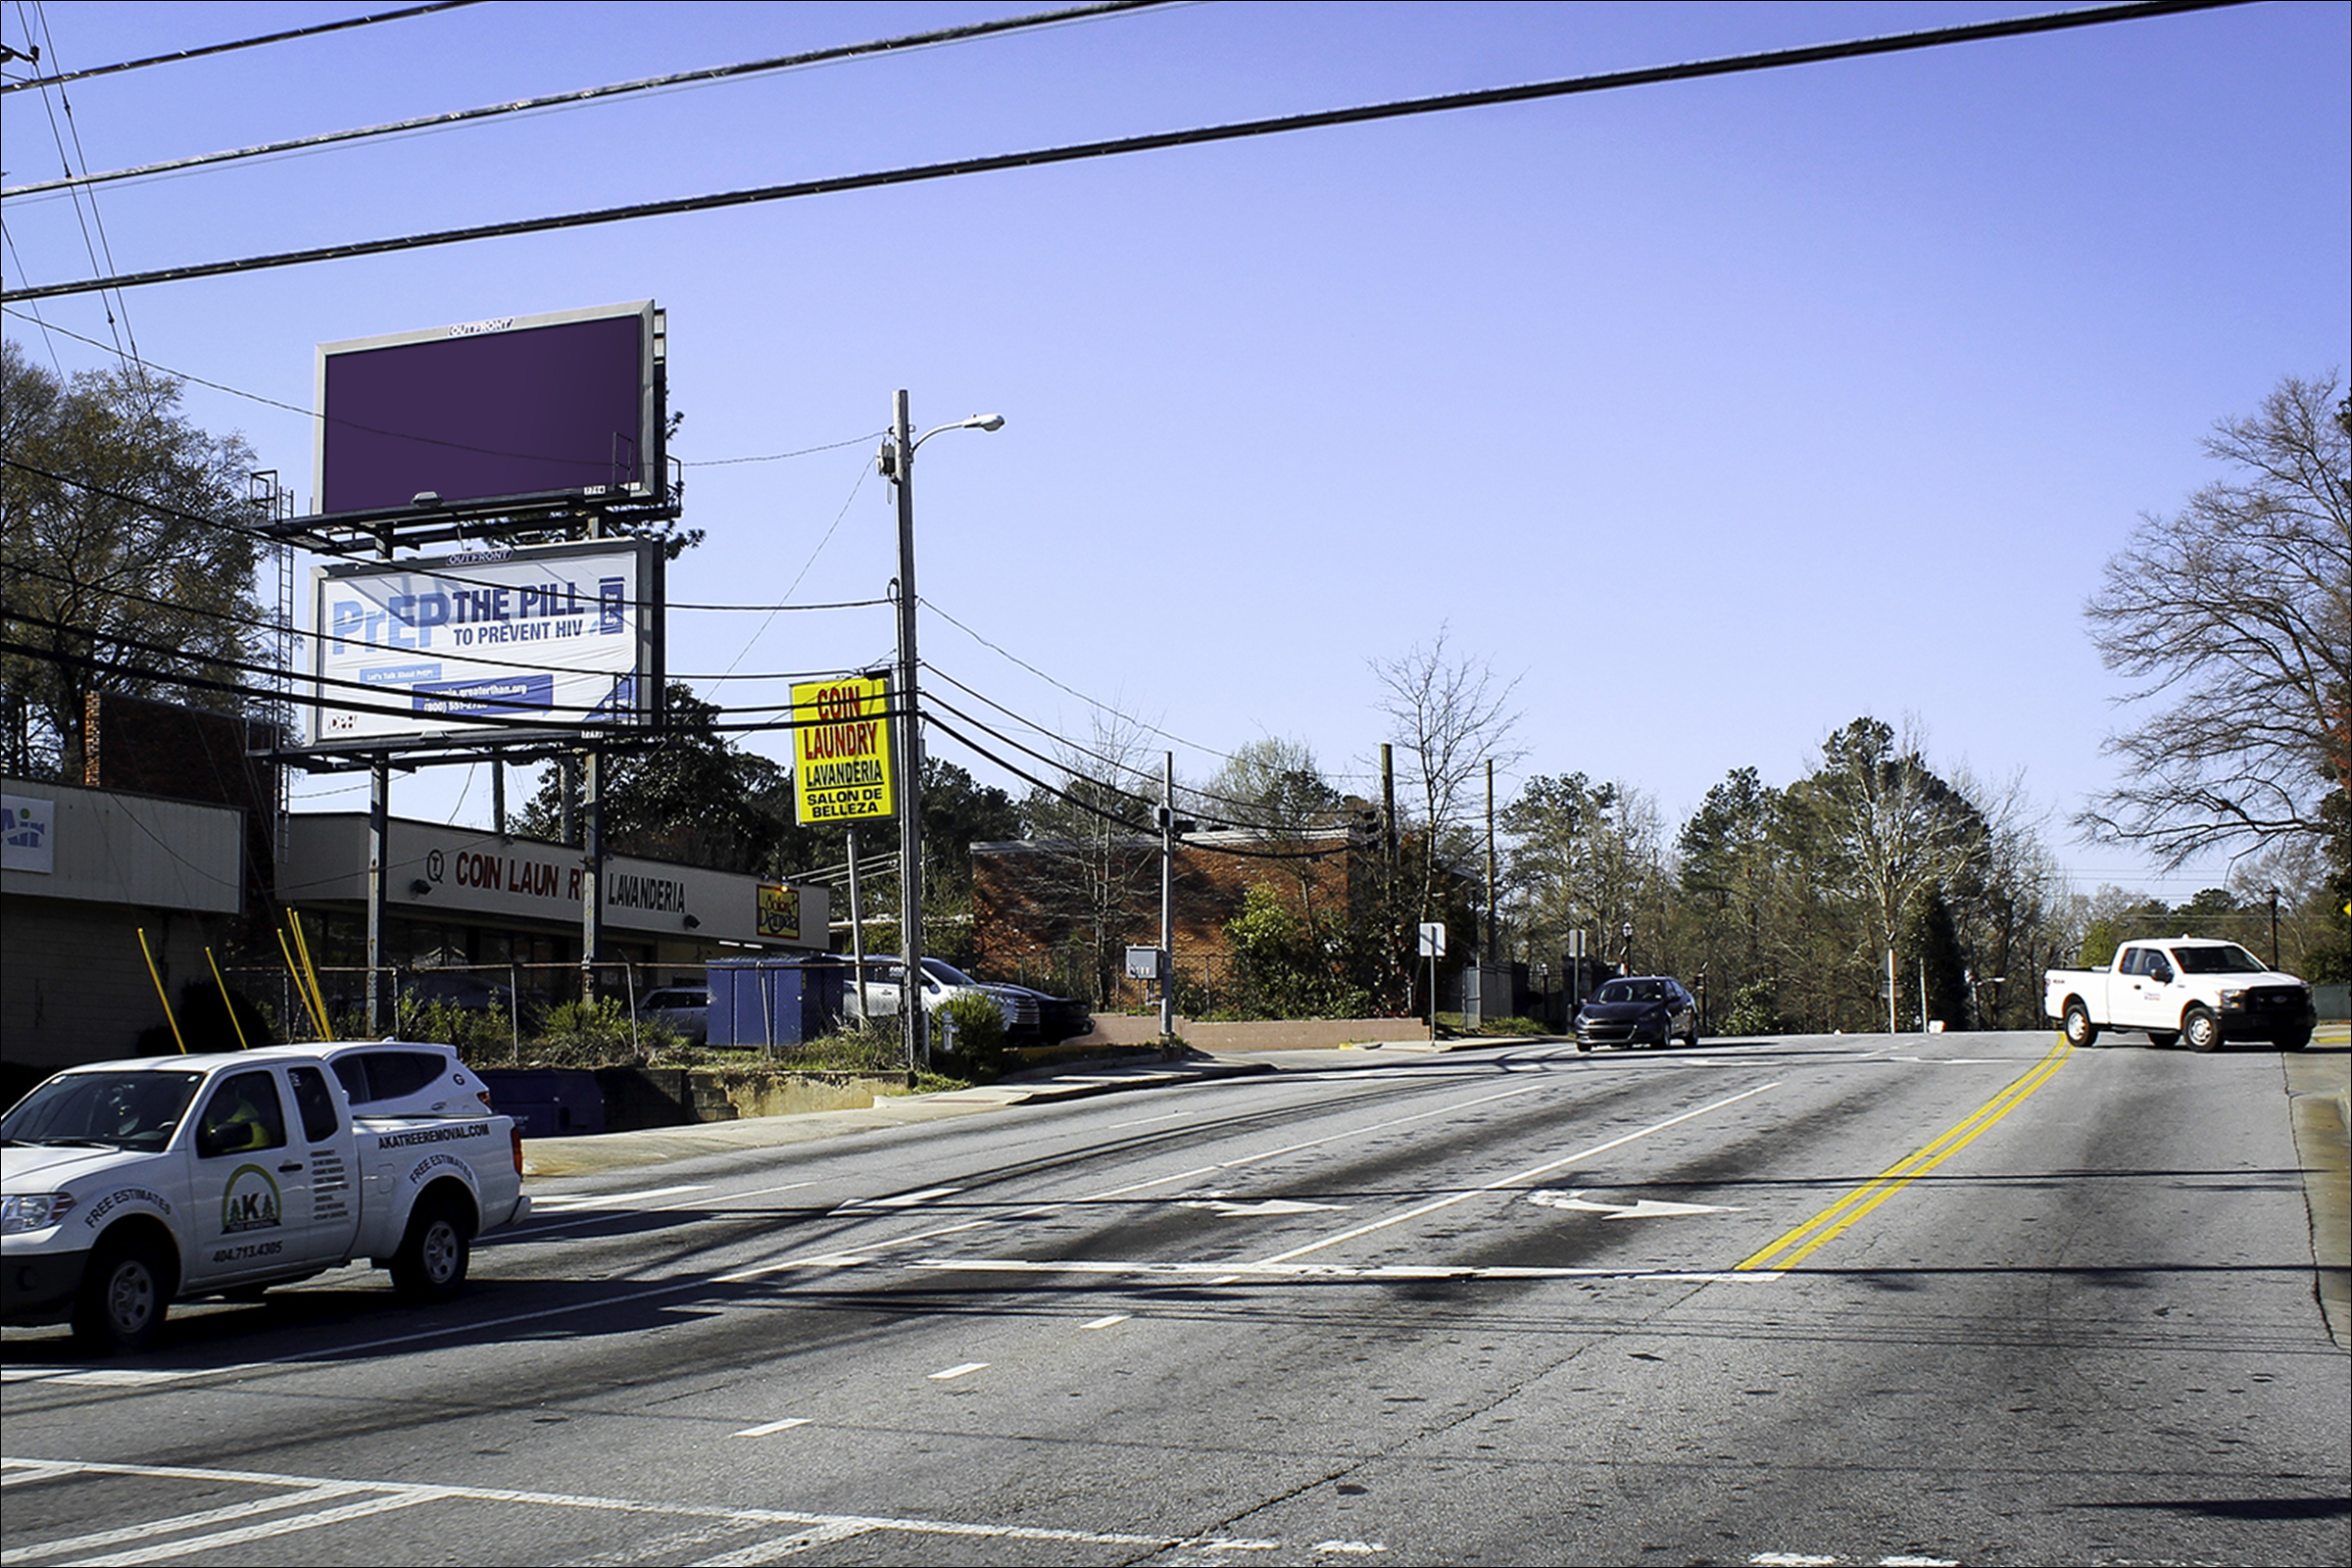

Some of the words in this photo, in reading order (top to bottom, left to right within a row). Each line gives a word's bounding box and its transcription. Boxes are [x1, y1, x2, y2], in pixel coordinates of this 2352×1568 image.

[449, 317, 514, 337] OUTFRONT
[448, 549, 513, 565] OUTFRONT
[453, 588, 510, 623] THE
[519, 582, 585, 618] PILL
[333, 592, 450, 655] PrEP
[454, 627, 473, 646] TO
[478, 622, 551, 644] PREVENT
[556, 619, 583, 638] HIV
[817, 686, 861, 720] COIN
[804, 722, 877, 760] LAUNDRY
[806, 760, 883, 787] LAVANDERIA
[807, 790, 858, 806] SALON
[862, 788, 883, 800] DE
[812, 802, 878, 818] BELLEZA
[456, 851, 503, 891] COIN
[608, 873, 685, 913] LAVANDERIA
[378, 1124, 490, 1151] AKATREEREMOVAL.COM
[409, 1160, 432, 1184] FREE
[430, 1153, 473, 1181] ESTIMATES
[84, 1197, 116, 1228] FREE
[112, 1188, 172, 1215] ESTIMATES
[213, 1241, 283, 1262] 404.713.4305
